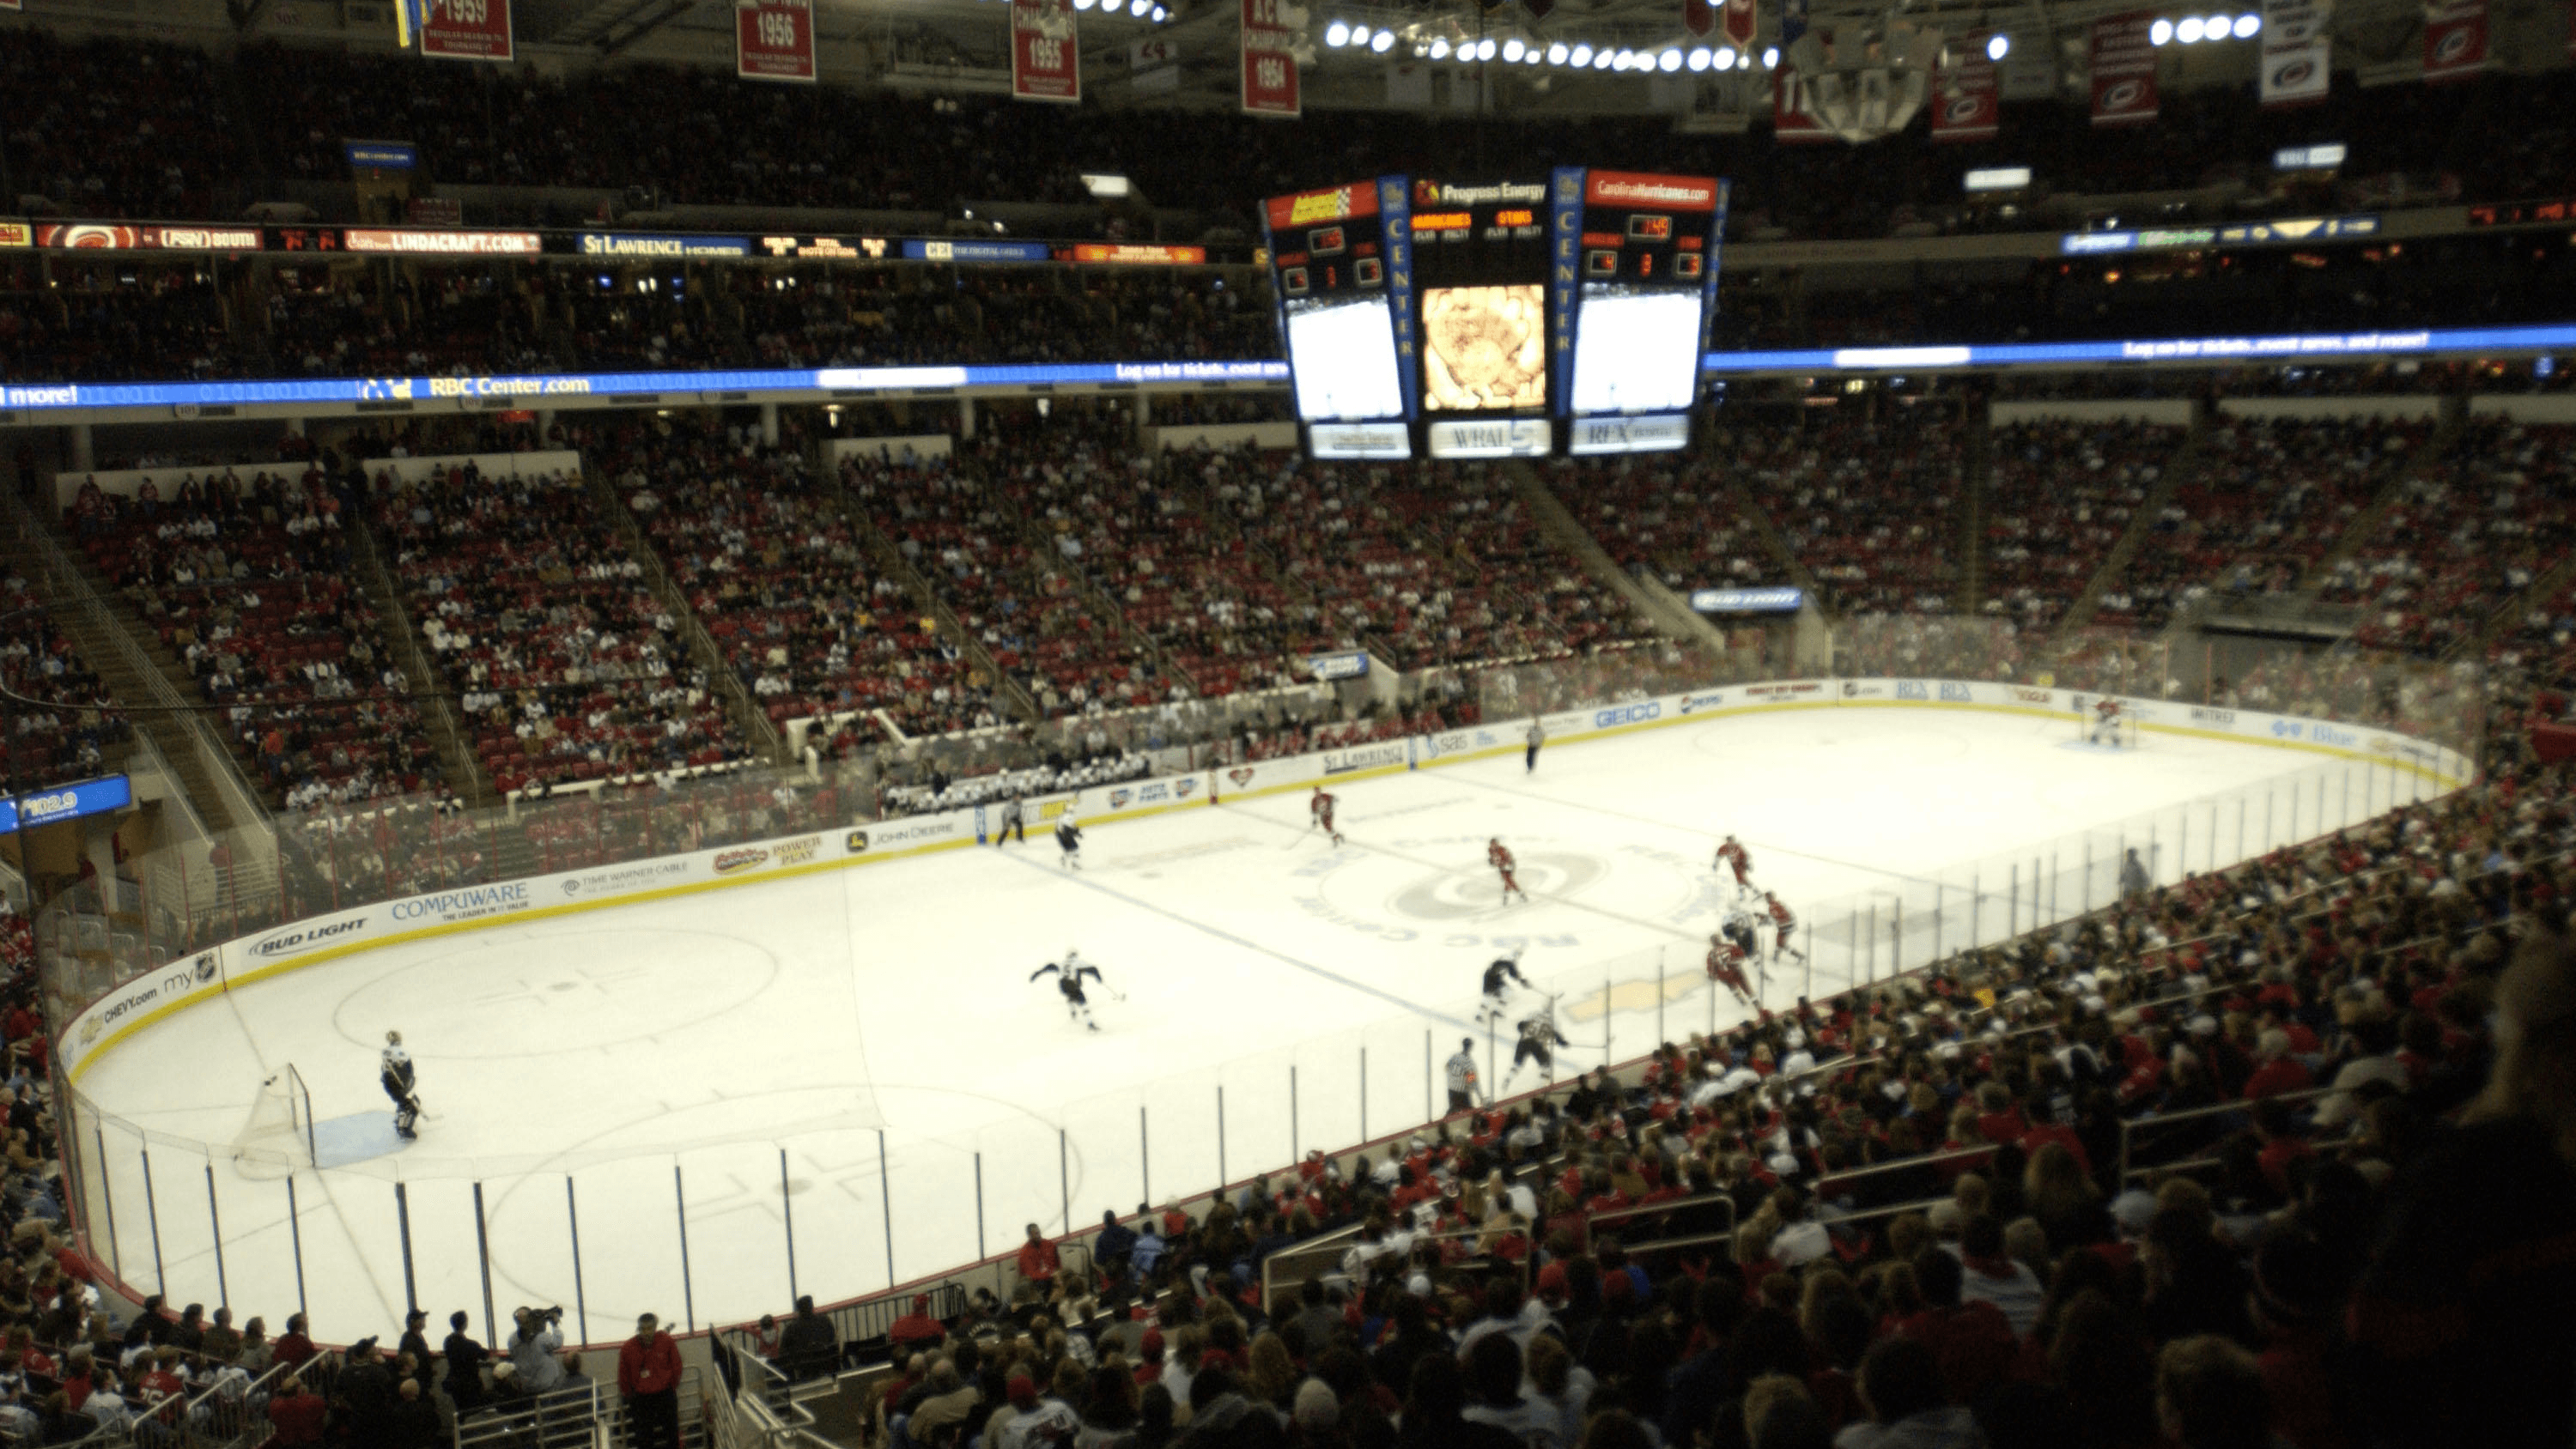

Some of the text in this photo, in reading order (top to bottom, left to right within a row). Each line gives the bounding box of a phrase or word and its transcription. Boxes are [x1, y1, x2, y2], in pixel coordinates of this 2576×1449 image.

[757, 11, 794, 46] 1956
[1030, 38, 1062, 70] 1955
[1443, 182, 1546, 206] Progress Energy
[392, 233, 525, 252] LINDACRAFT.COM
[604, 235, 683, 255] LAWRENCE
[1387, 218, 1413, 356] CENTER
[1117, 362, 1144, 381] Log
[9, 384, 77, 406] more!
[430, 378, 472, 397] RBC
[476, 376, 590, 396] Center.com
[1453, 427, 1504, 448] WRAL
[1595, 701, 1661, 728] GEICO
[1343, 743, 1404, 767] LAWRENCE
[874, 822, 954, 846] JOHN DEERE
[773, 836, 822, 857] POWER
[781, 849, 815, 864] PLAY
[583, 861, 688, 886] TIME WARNER CABLE
[392, 882, 528, 921] COMPUWARE
[442, 912, 458, 922] THE
[458, 907, 487, 919] LEADER
[507, 900, 529, 912] VALUE
[260, 917, 368, 955] BUD LIGHT
[163, 969, 194, 992] my
[104, 987, 158, 1025] CHEVY.com
